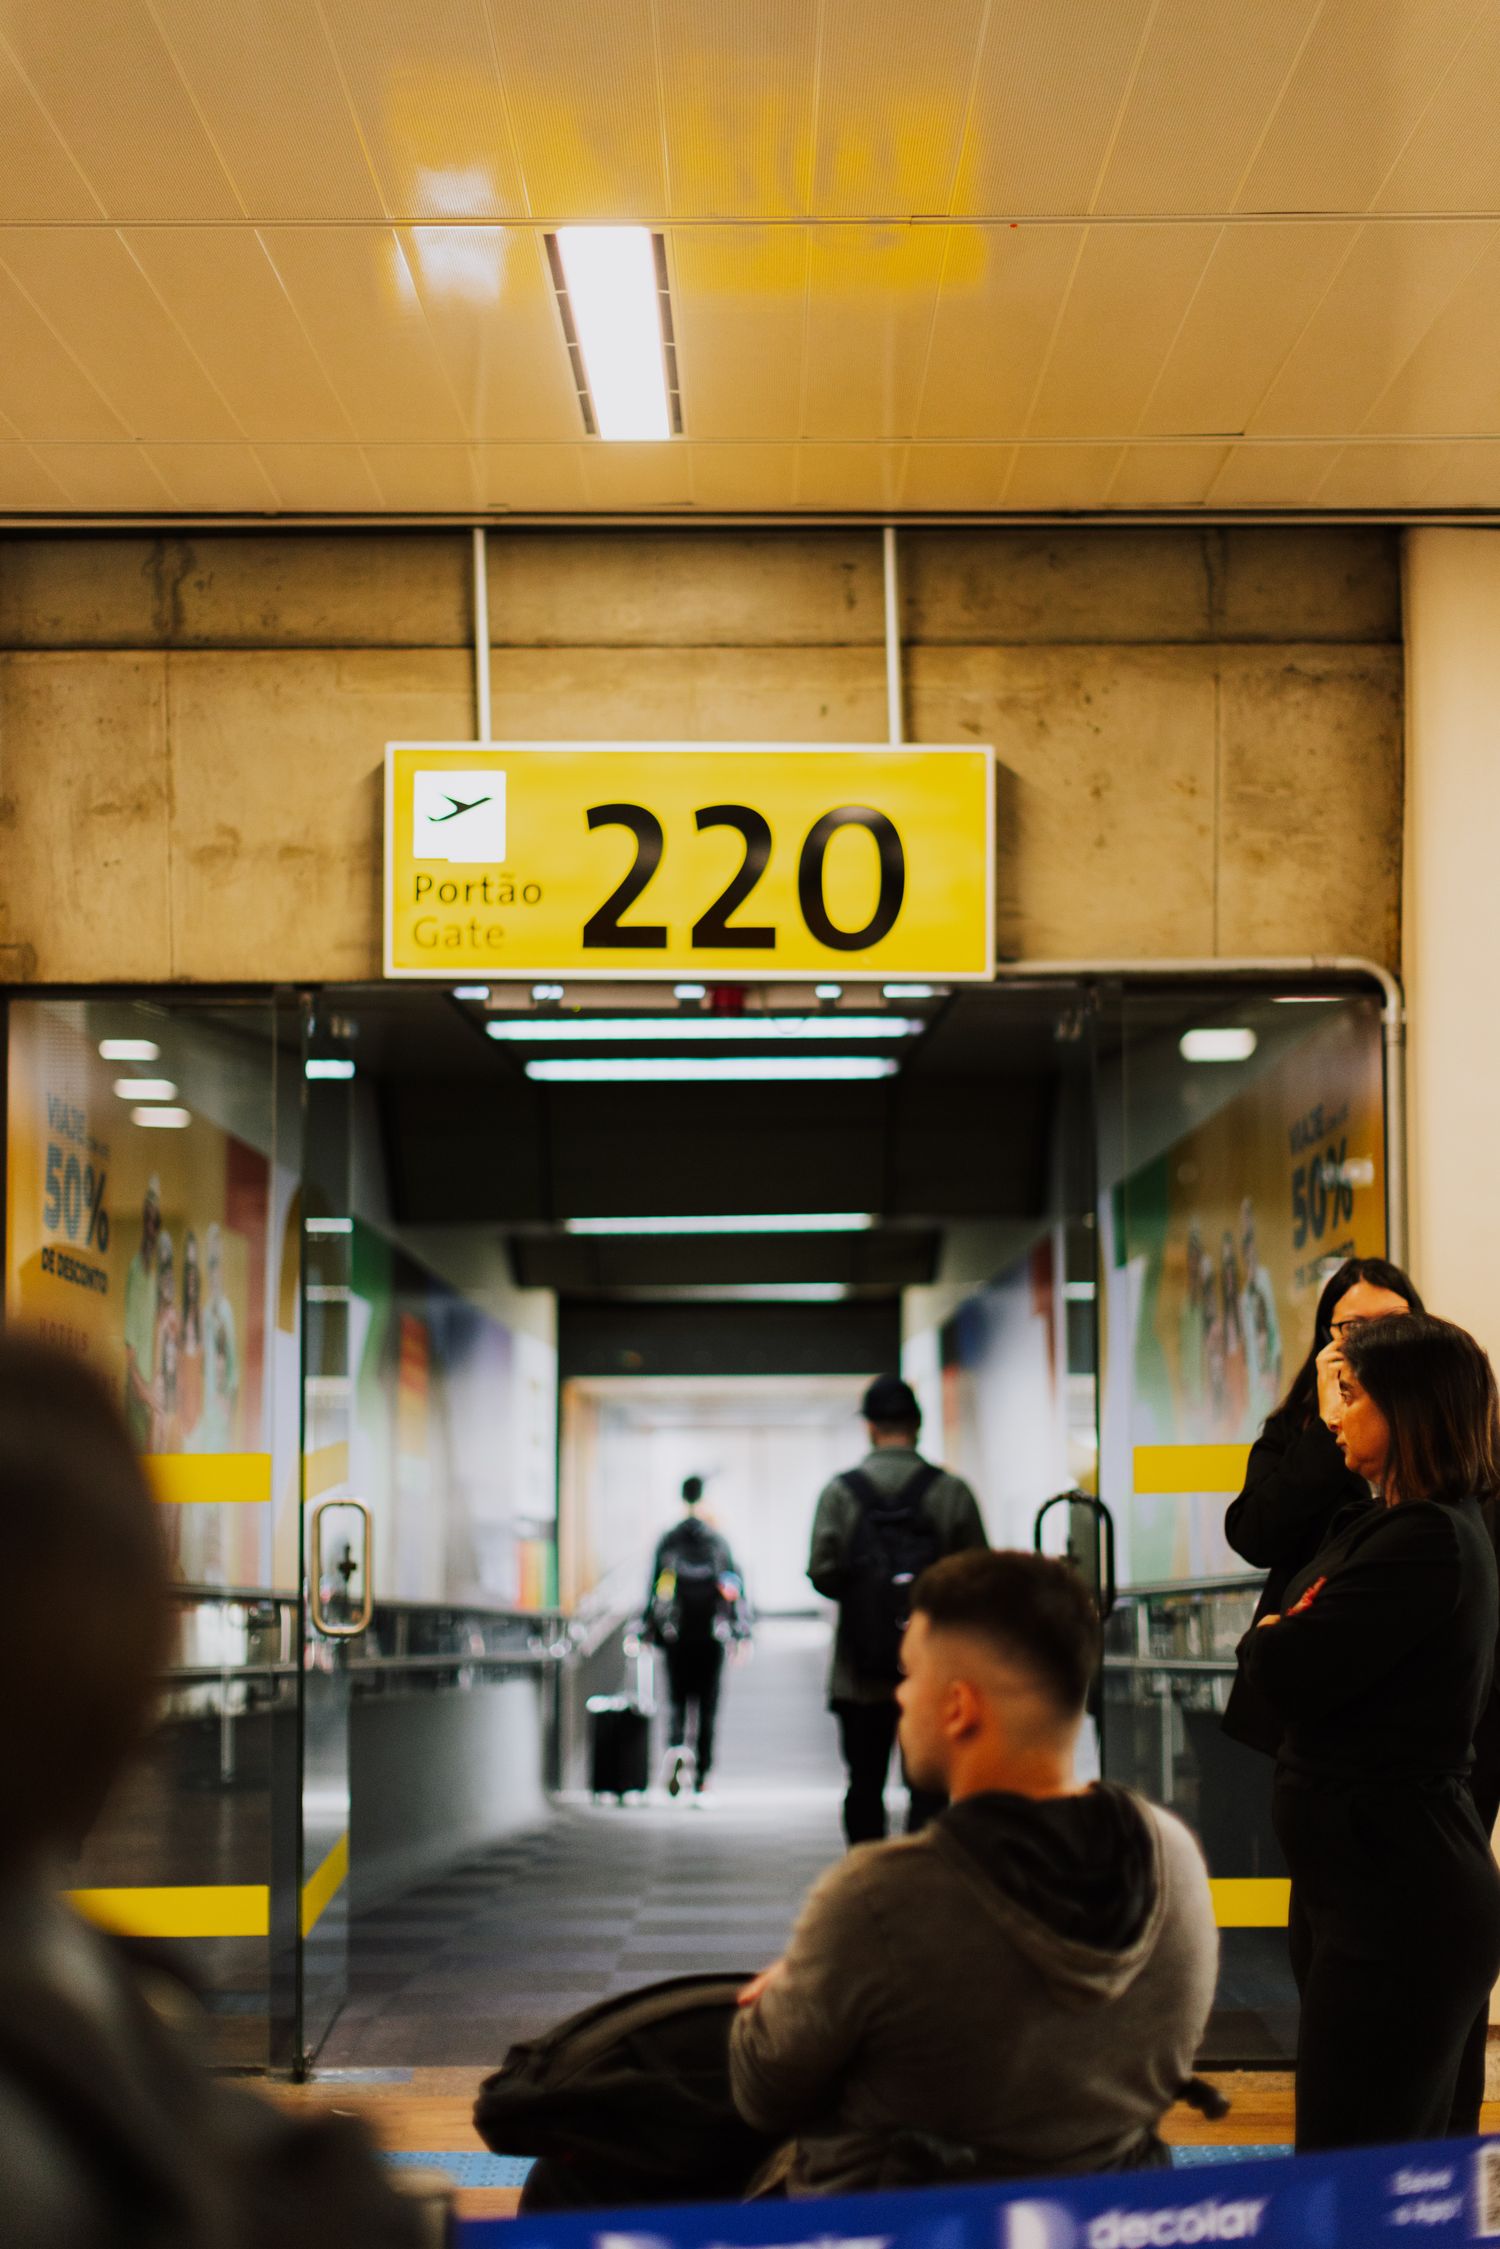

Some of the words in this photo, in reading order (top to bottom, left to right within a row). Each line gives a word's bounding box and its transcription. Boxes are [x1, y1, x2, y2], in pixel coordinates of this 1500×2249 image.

[415, 872, 542, 905] Portão
[582, 803, 905, 951] 220
[413, 916, 504, 949] Gate
[44, 1143, 109, 1253] 50%
[1089, 2199, 1269, 2249] decolar
